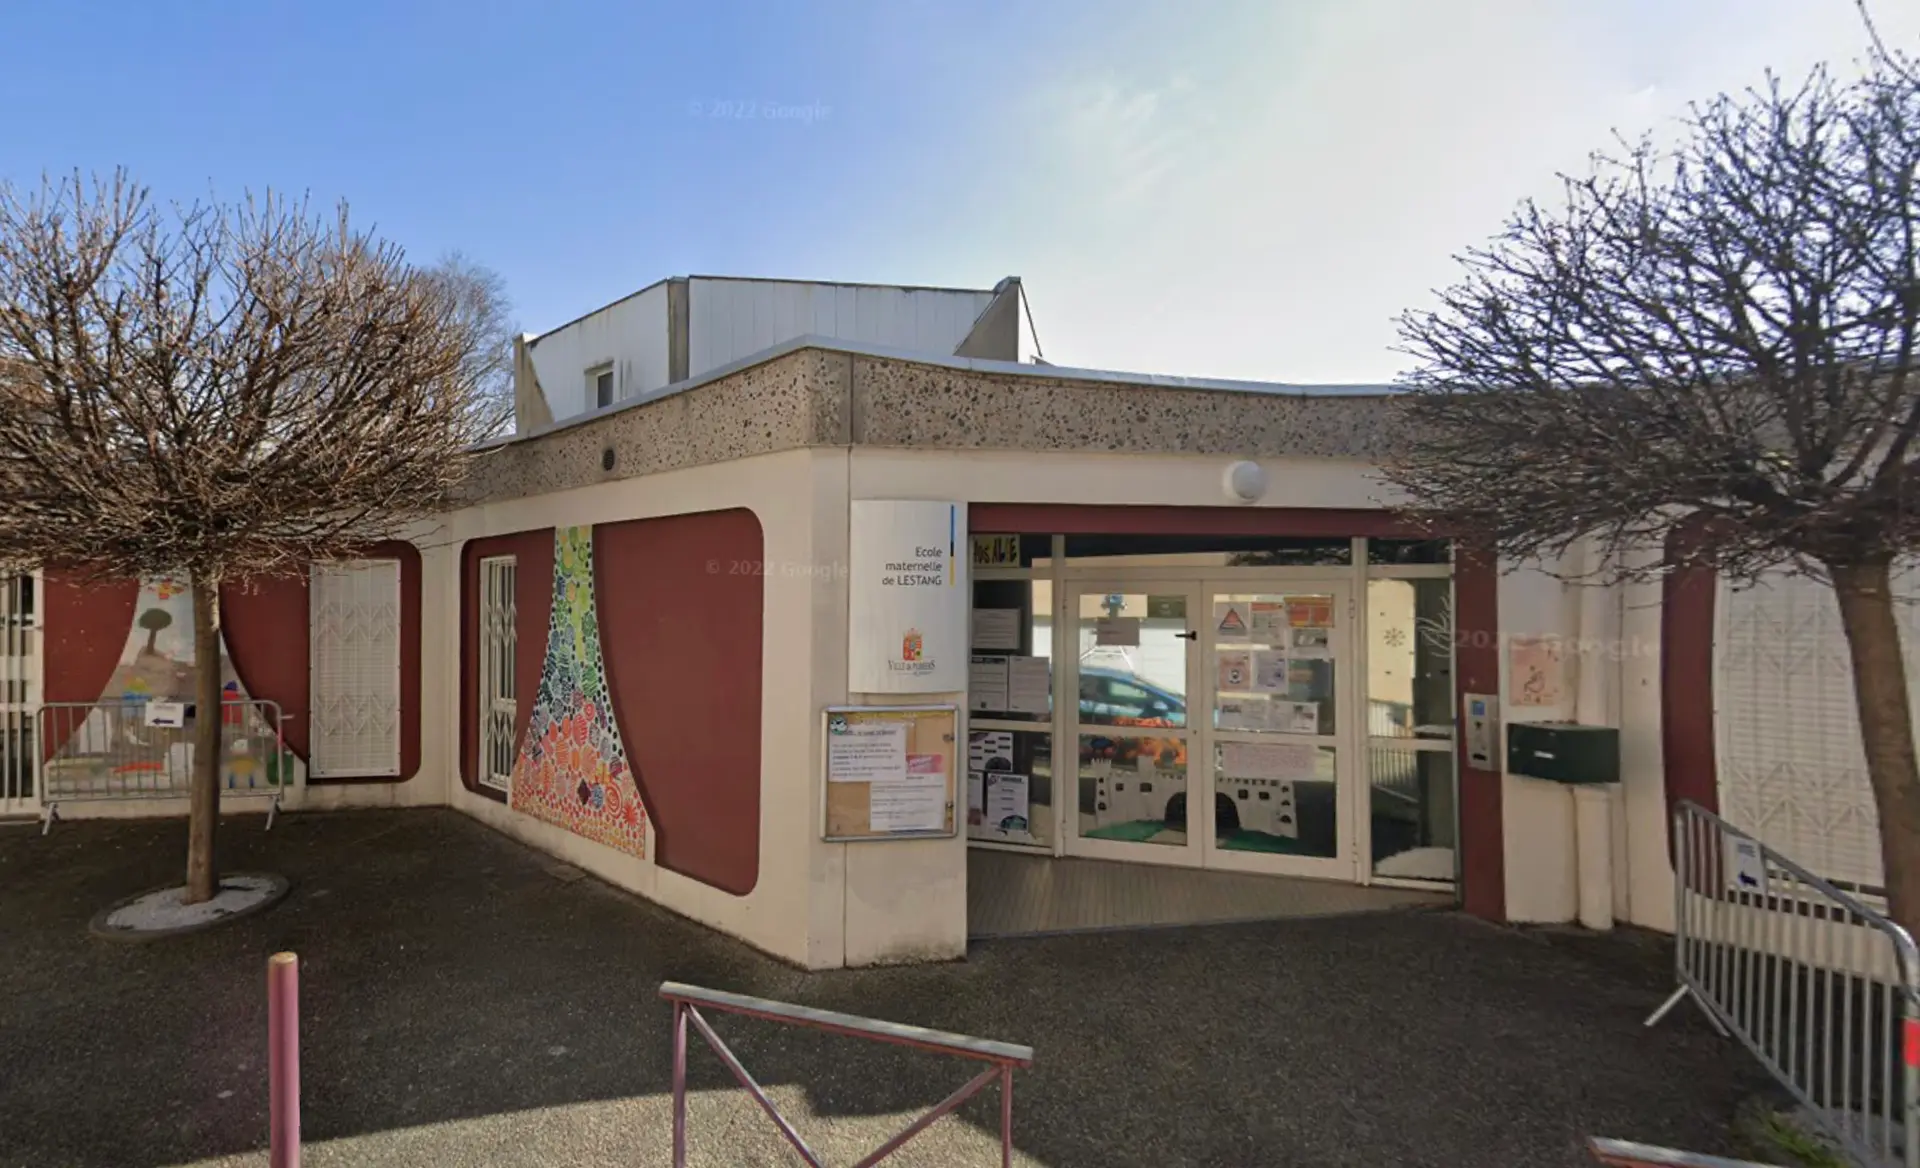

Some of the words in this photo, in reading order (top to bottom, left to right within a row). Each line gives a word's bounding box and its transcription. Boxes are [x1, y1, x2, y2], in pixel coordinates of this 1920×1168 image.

[915, 546, 942, 557] Ecole
[885, 561, 942, 571] maternelle
[882, 576, 895, 585] de
[897, 575, 942, 586] LESTANG
